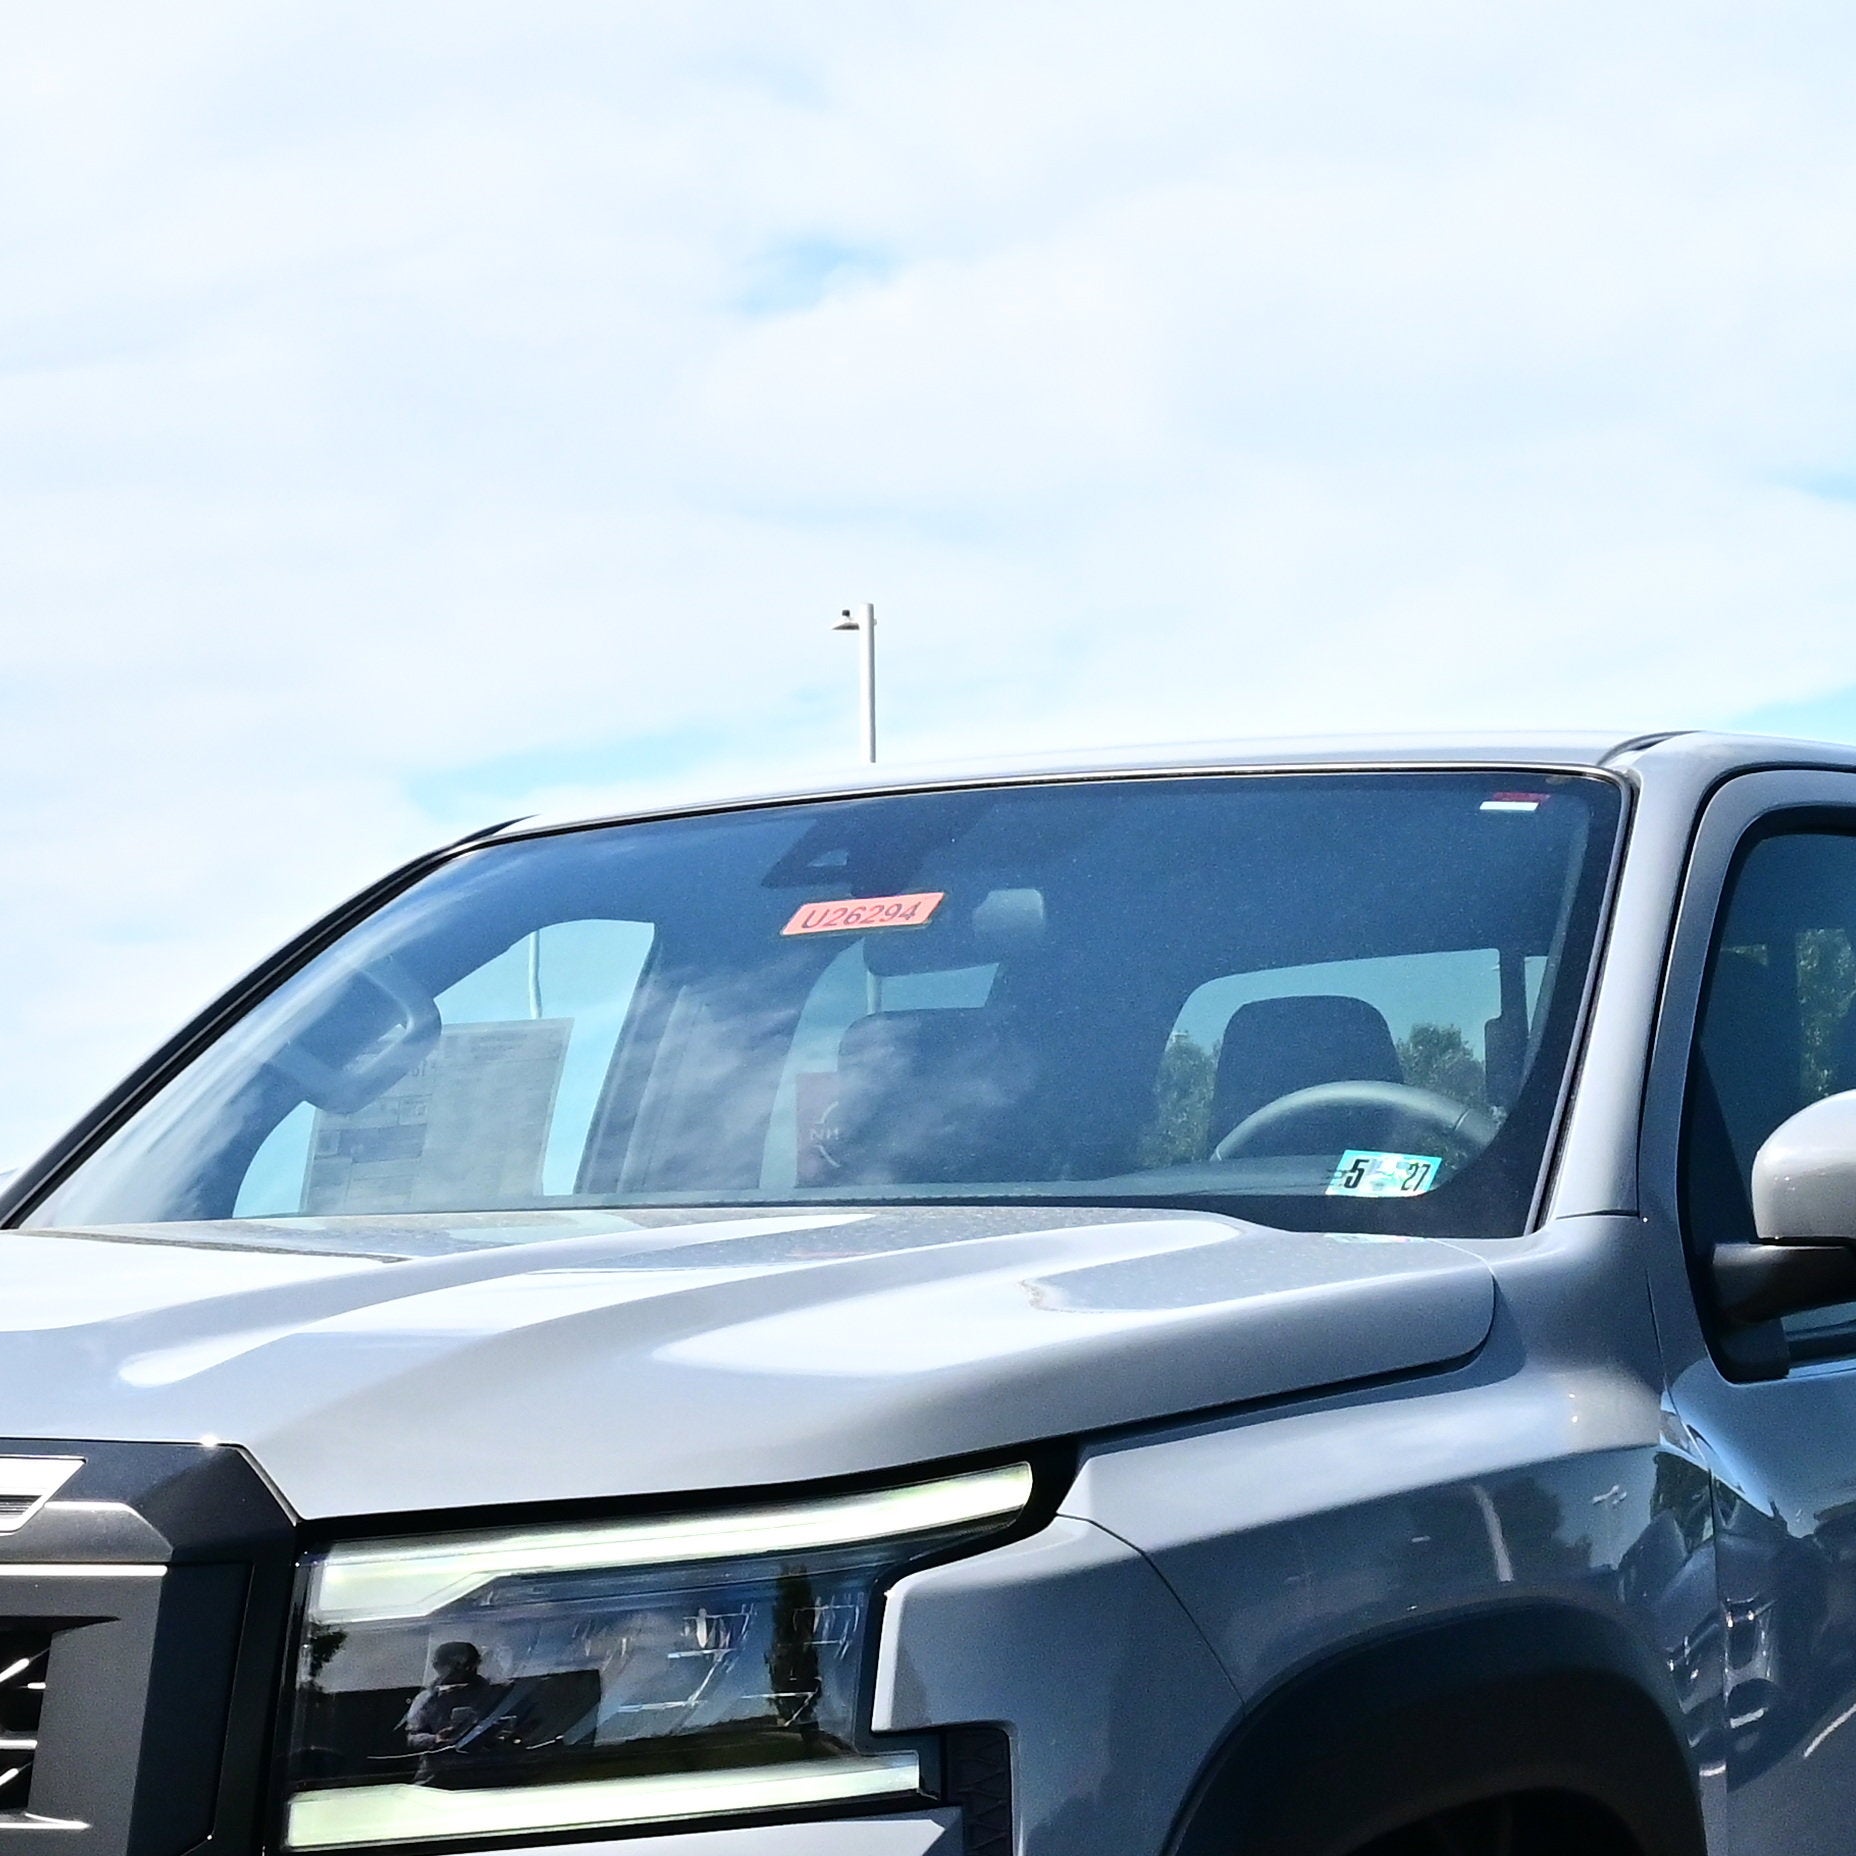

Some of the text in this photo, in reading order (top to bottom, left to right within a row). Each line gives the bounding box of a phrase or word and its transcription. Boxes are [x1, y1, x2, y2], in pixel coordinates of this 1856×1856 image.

[801, 901, 921, 929] U26294
[1344, 1159, 1431, 1191] 5 27
